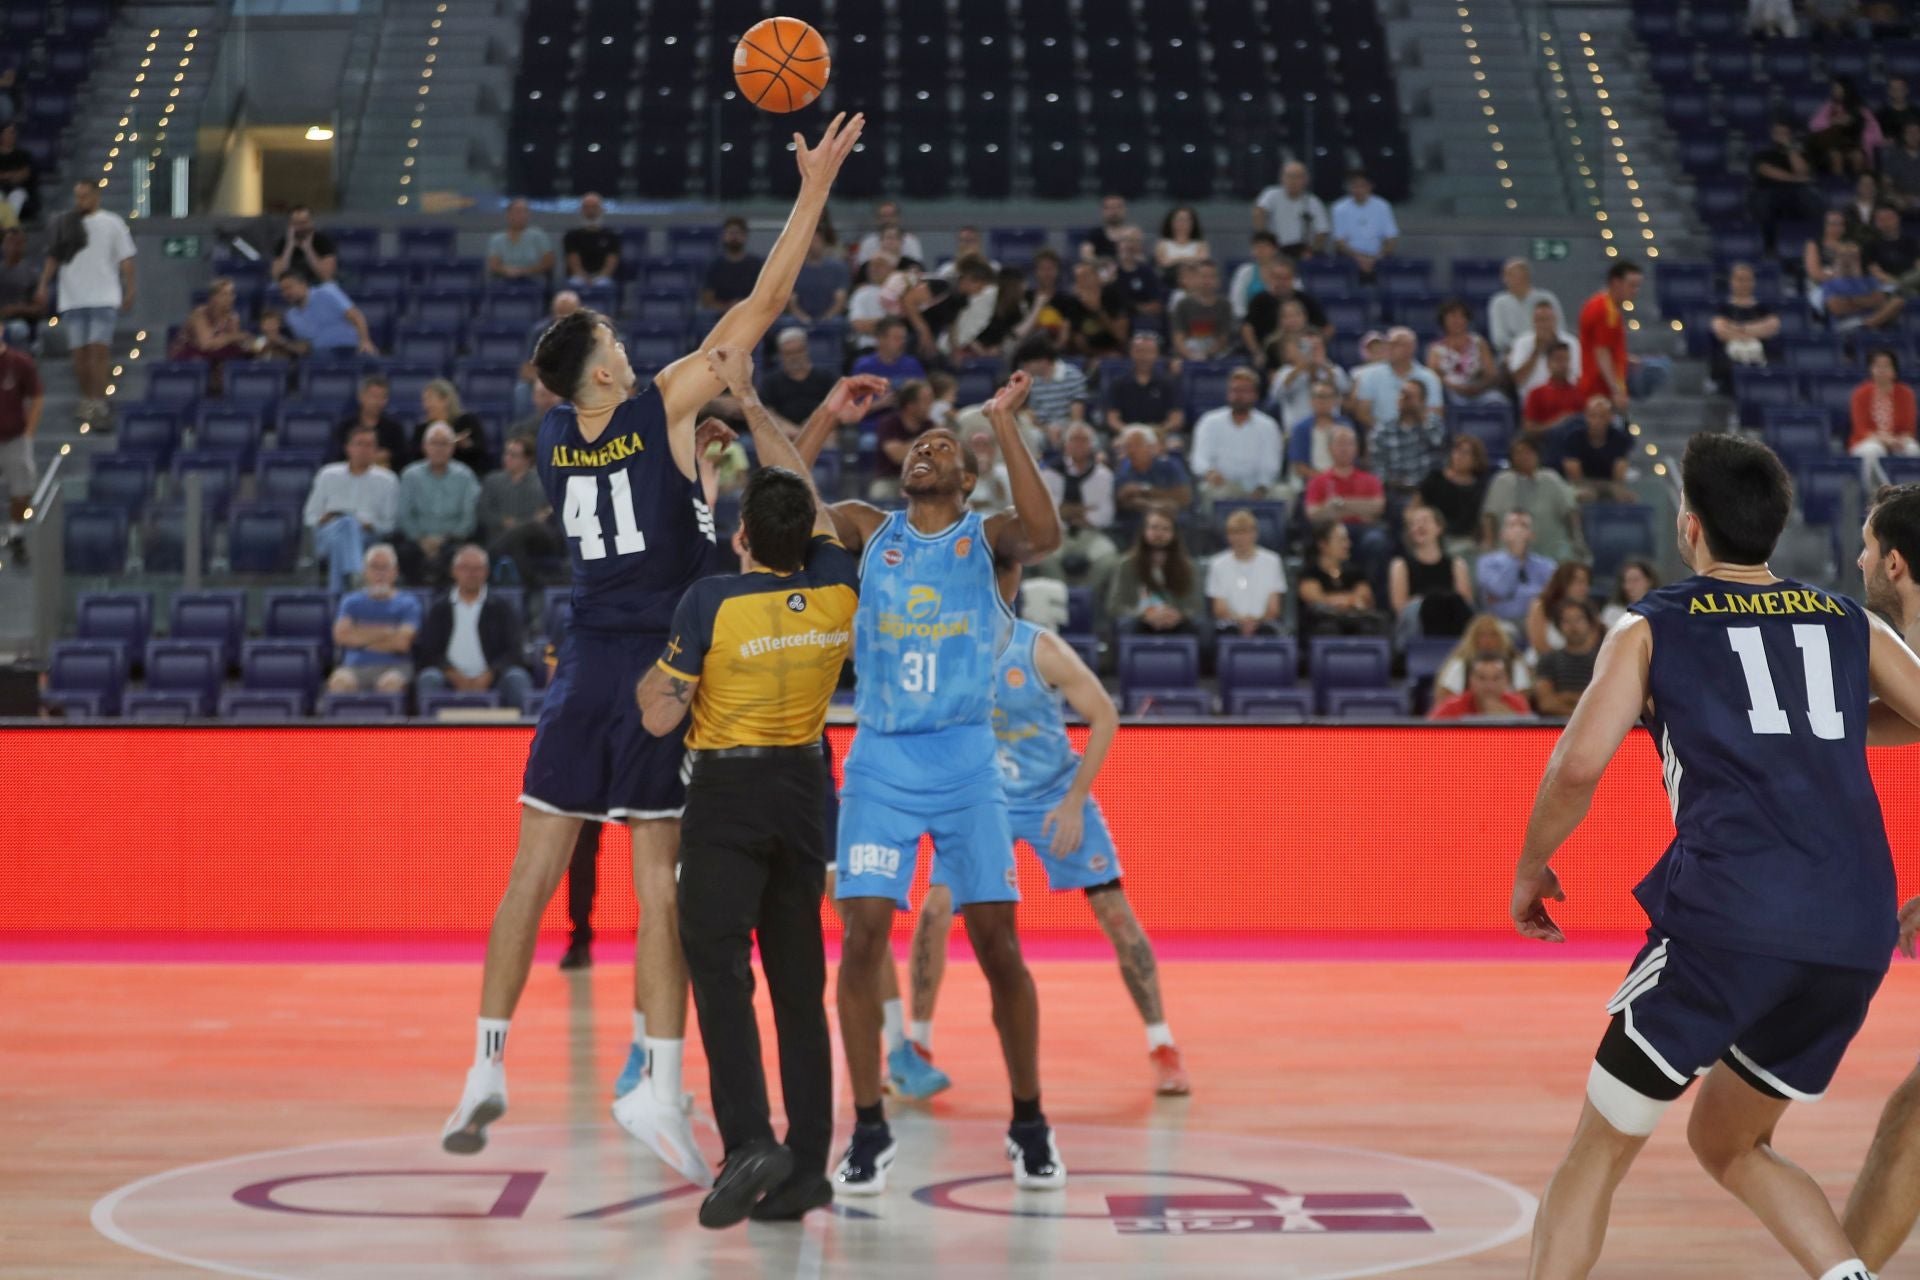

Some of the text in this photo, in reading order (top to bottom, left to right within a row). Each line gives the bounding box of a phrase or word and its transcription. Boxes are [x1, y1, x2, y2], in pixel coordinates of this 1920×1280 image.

[551, 432, 644, 467] ALIMERKA
[562, 467, 646, 560] 41
[1689, 590, 1845, 616] ALIMERKA
[879, 616, 969, 640] agropal
[903, 652, 936, 692] 31
[1727, 623, 1845, 740] 11
[849, 844, 900, 877] gaza
